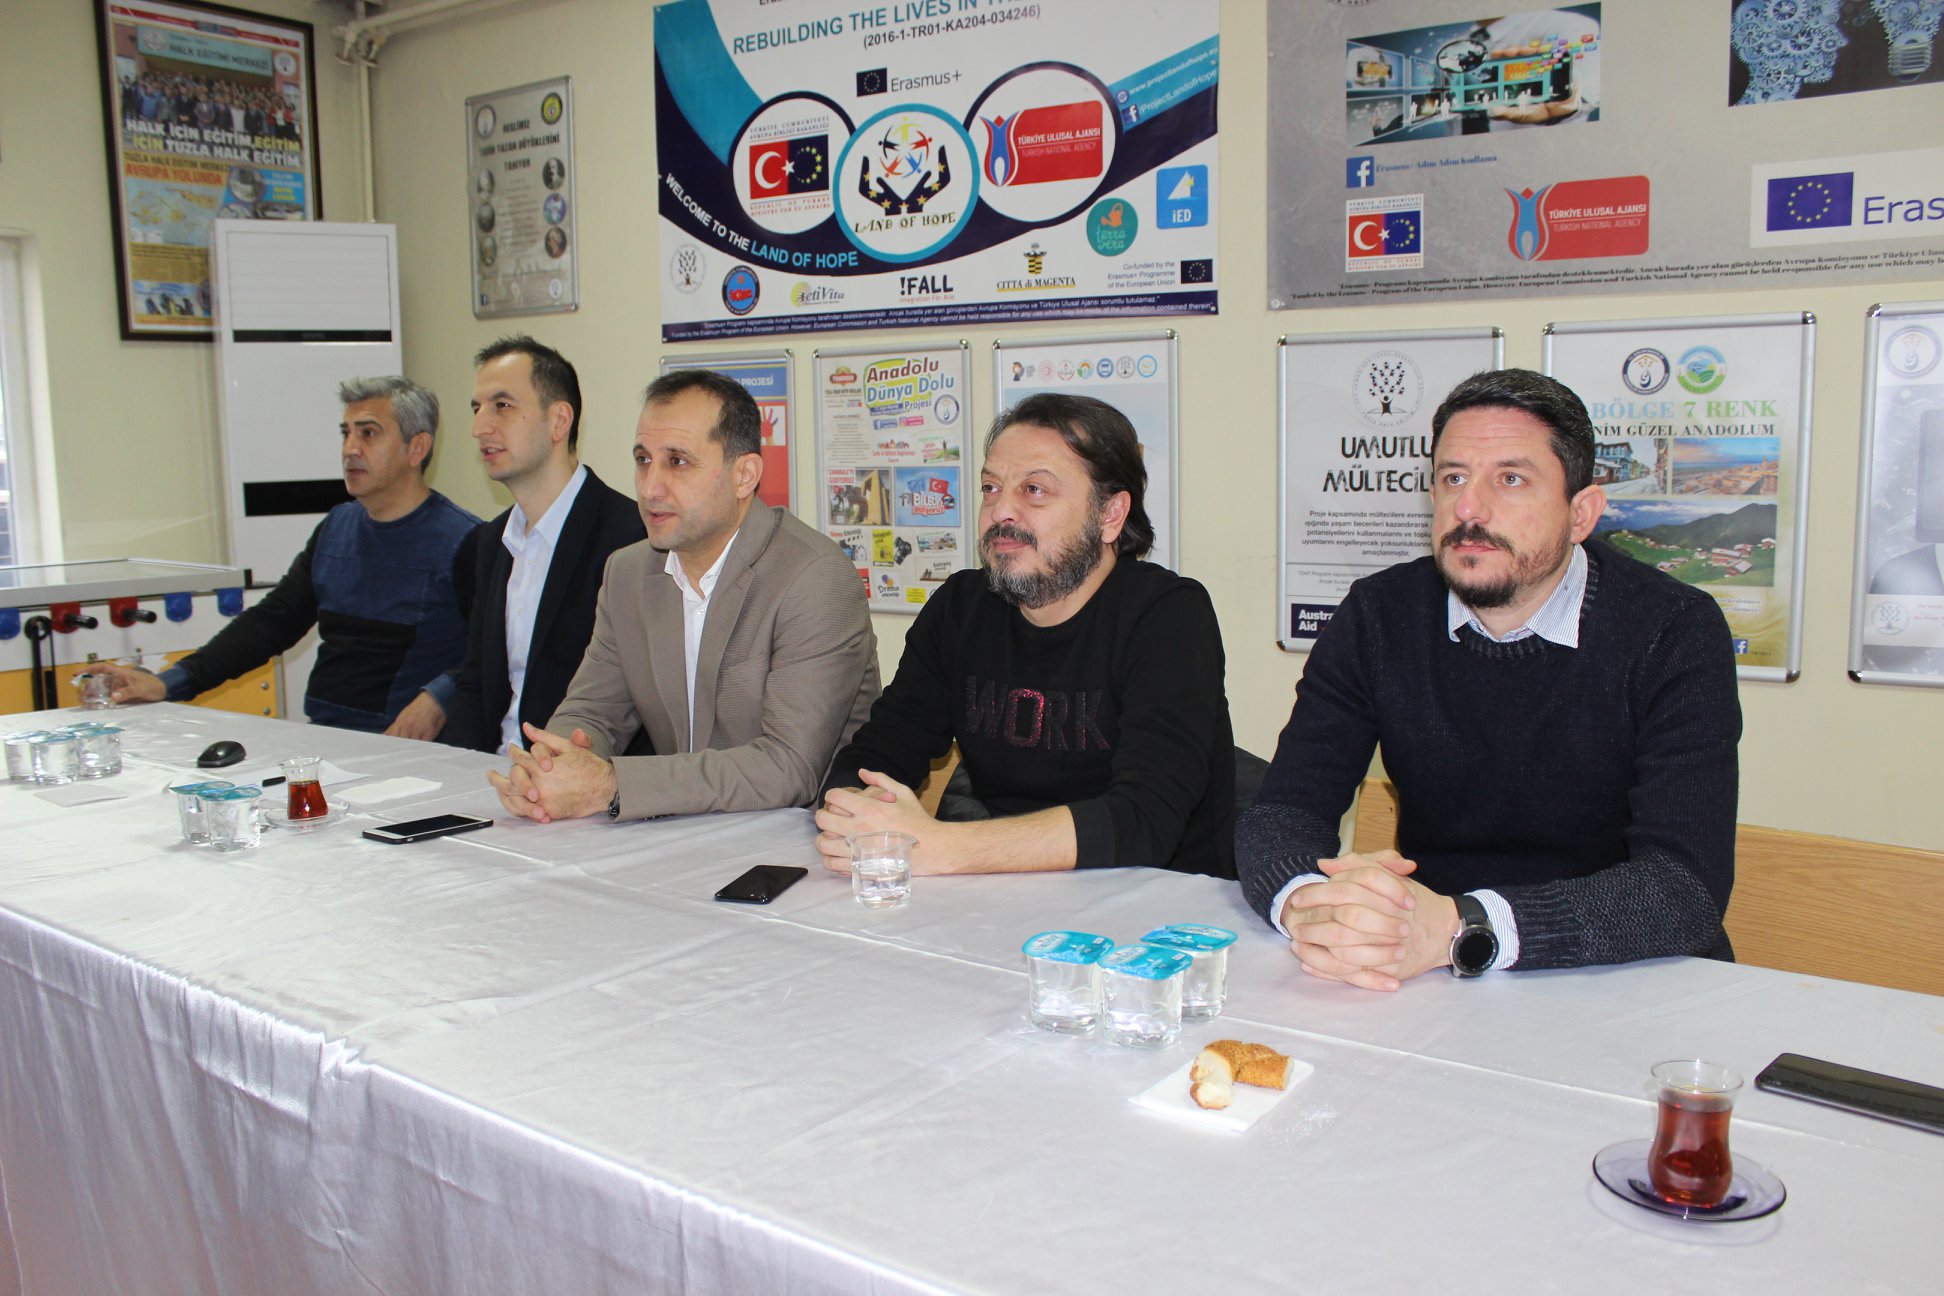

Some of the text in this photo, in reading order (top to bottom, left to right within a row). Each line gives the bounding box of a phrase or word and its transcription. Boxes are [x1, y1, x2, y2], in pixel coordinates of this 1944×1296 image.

[733, 16, 844, 55] REBUILDING
[849, 7, 888, 32] THE
[894, 0, 951, 24] LIVES
[863, 3, 1041, 50] (2016-1-TR01-KA204-034246)
[891, 69, 962, 92] Erasmus+
[126, 118, 166, 136] HALK
[170, 122, 200, 141] İÇİN
[1018, 127, 1101, 146] TÜRKİYE ULUSAL AJANSI
[133, 134, 300, 167] İÇİN TUZLA HALK EĞİTİM
[125, 161, 223, 186] AVRUPA YOLUNDA
[1172, 208, 1192, 224] iED
[1549, 203, 1647, 219] TÜRKİYE ULUSAL AJANSI
[665, 172, 859, 269] WELCOME TO THE LAND OF HOPE
[855, 211, 956, 233] LAND OF HOPE
[1882, 250, 1920, 260] Türkiye
[1123, 261, 1154, 270] Co-funded
[1155, 261, 1164, 270] by
[1139, 270, 1176, 279] Programme
[1719, 269, 1748, 277] cannot
[1781, 264, 1833, 274] responsible
[1834, 263, 1848, 271] for
[1885, 259, 1914, 267] which
[1915, 259, 1935, 267] may
[1034, 276, 1076, 288] MAGENTA
[1126, 280, 1156, 289] European
[866, 357, 940, 384] Anadolu
[741, 374, 774, 387] PROJESİ
[867, 372, 955, 403] Dünya Dolu
[904, 398, 932, 411] Projesi
[1592, 397, 1780, 420] BÖLGE 7 RENK
[1626, 422, 1678, 437] GÜZEL
[1681, 423, 1776, 436] ANADOLUM
[1341, 435, 1433, 459] UMUTLU
[1323, 463, 1434, 493] MÜLTECİL
[1309, 510, 1327, 519] Proje
[1327, 511, 1368, 519] kapsamında
[1368, 511, 1406, 519] mültecilere
[1330, 521, 1353, 529] yaşam
[1353, 520, 1385, 528] becerileri
[1385, 521, 1429, 529] kazandırarak
[1302, 539, 1335, 547] uyumlarını
[1336, 539, 1379, 547] engelleyecek
[1307, 530, 1356, 538] potansiyellerini
[1357, 530, 1403, 538] kullanmalarını
[1298, 620, 1318, 631] Aid
[965, 675, 1111, 752] WORK
